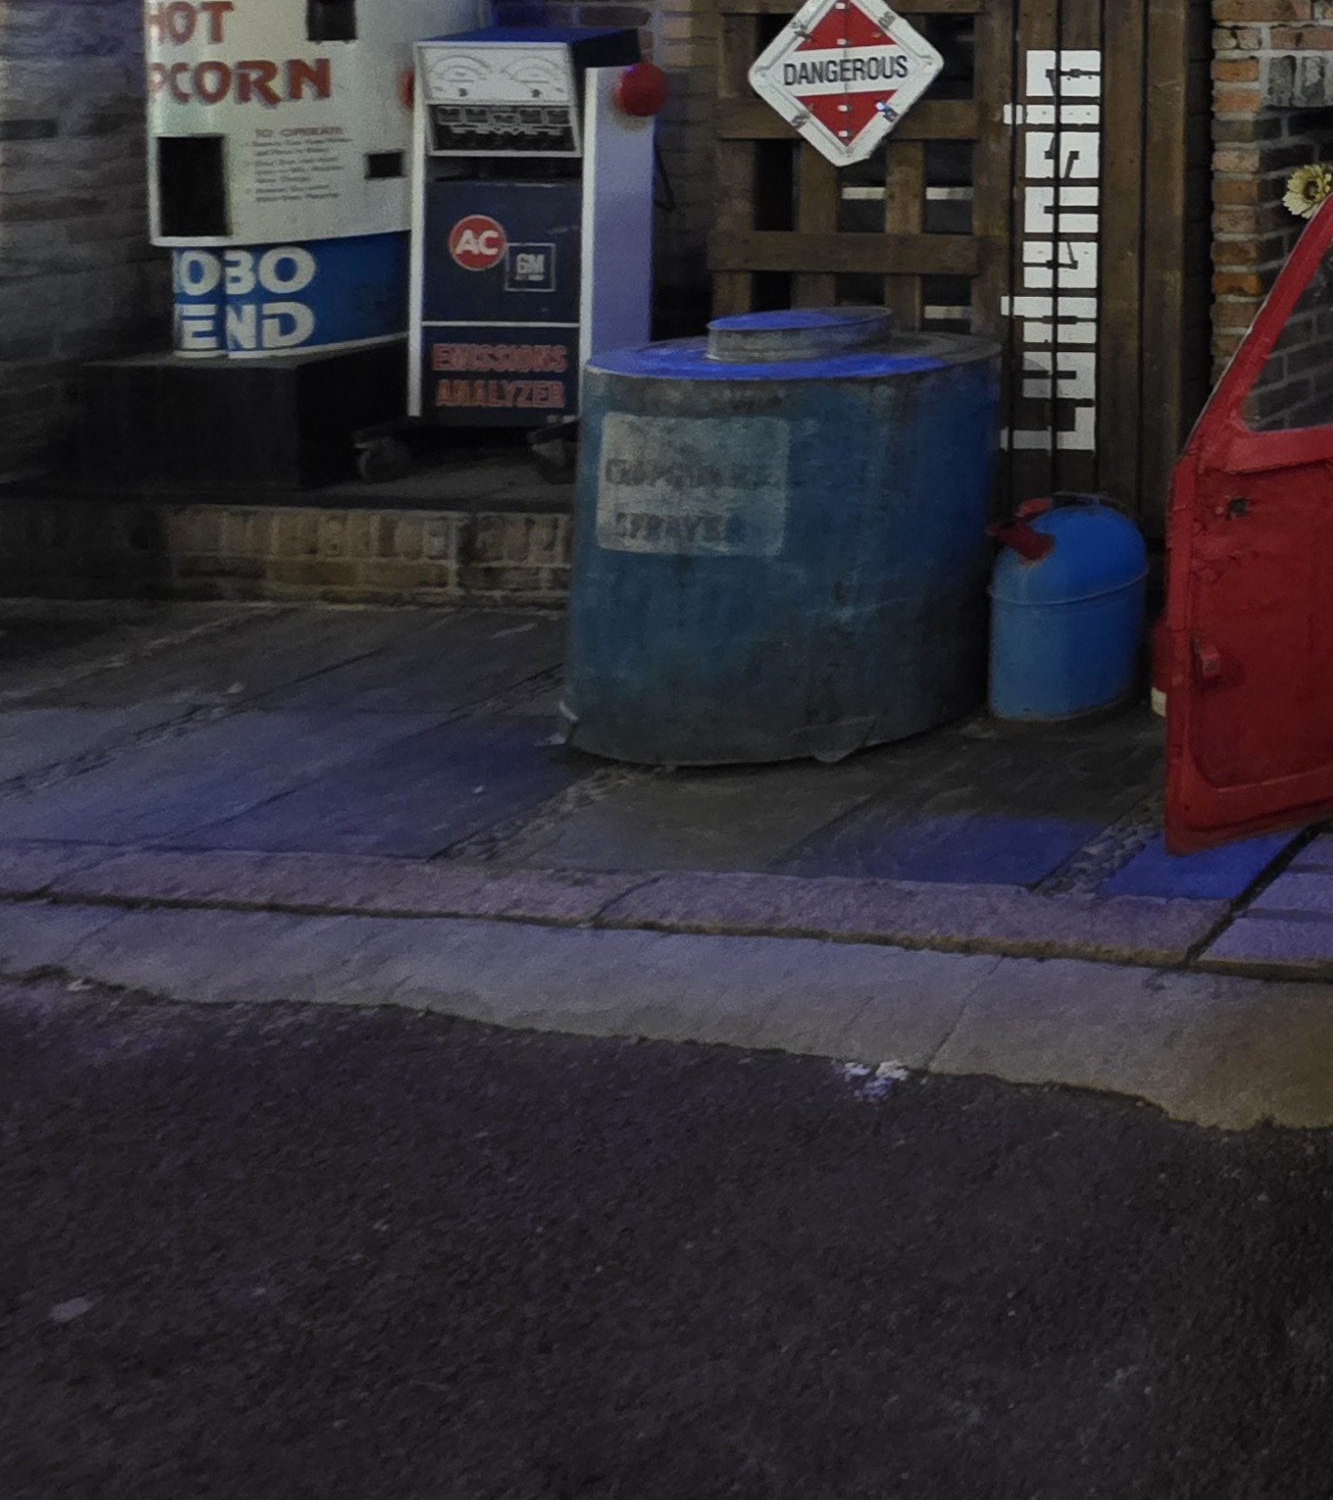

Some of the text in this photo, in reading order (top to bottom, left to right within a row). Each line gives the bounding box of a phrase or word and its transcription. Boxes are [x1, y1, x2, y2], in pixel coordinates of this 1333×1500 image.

[783, 55, 908, 86] DANGEROUS
[455, 229, 500, 256] AC
[515, 252, 545, 275] GM
[432, 342, 568, 373] EMISSIONS
[435, 378, 566, 408] ANALYZER
